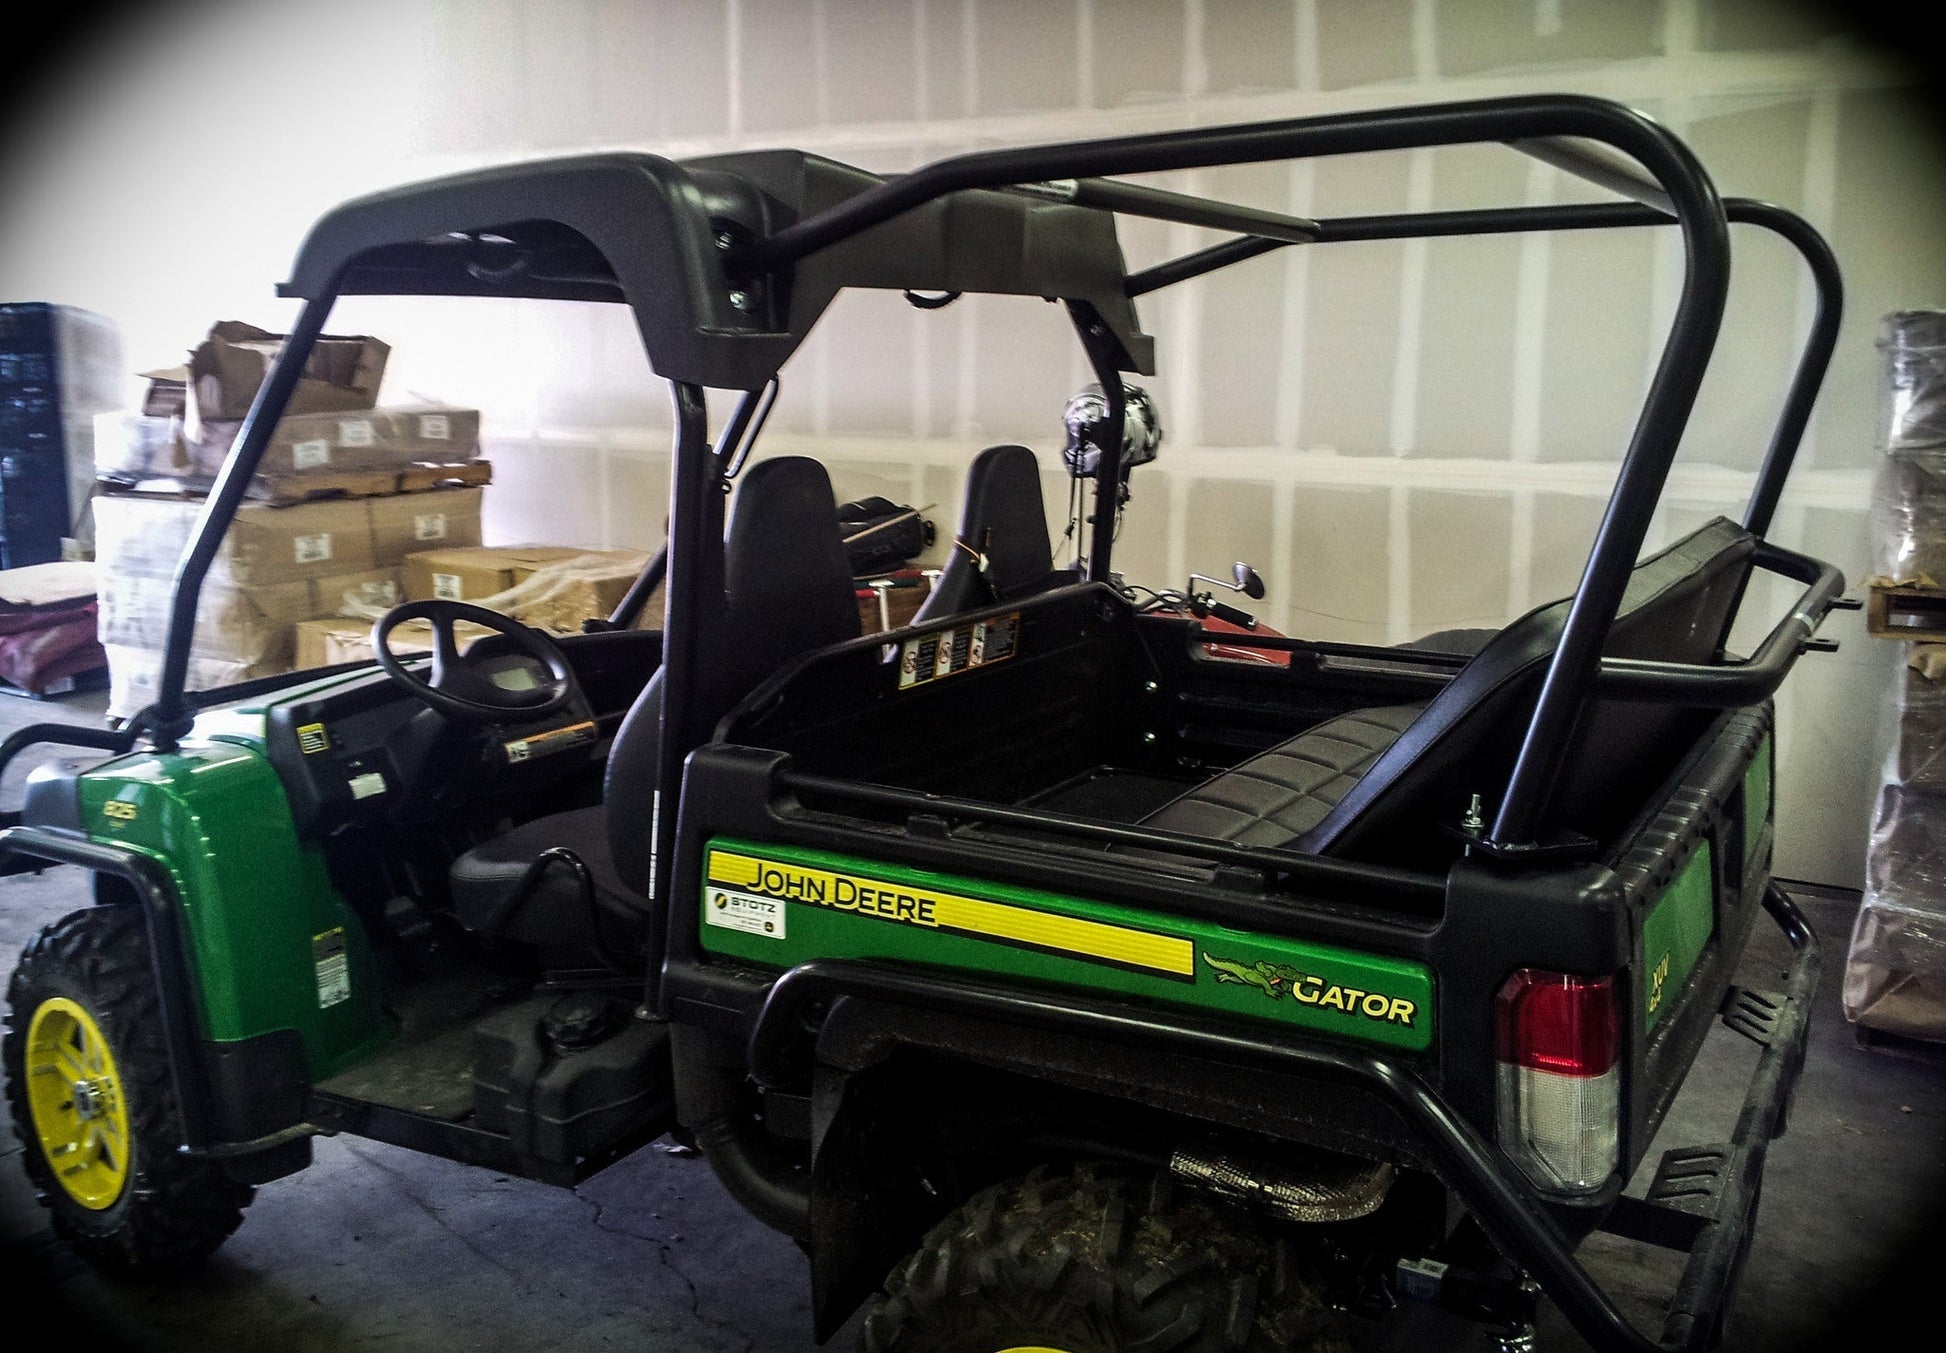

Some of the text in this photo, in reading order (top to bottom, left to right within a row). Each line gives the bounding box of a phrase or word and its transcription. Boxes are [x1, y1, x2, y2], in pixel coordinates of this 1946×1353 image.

[731, 896, 777, 913] STOTZ
[747, 863, 937, 923] JOHN DEERE
[1292, 976, 1415, 1024] GATOR
